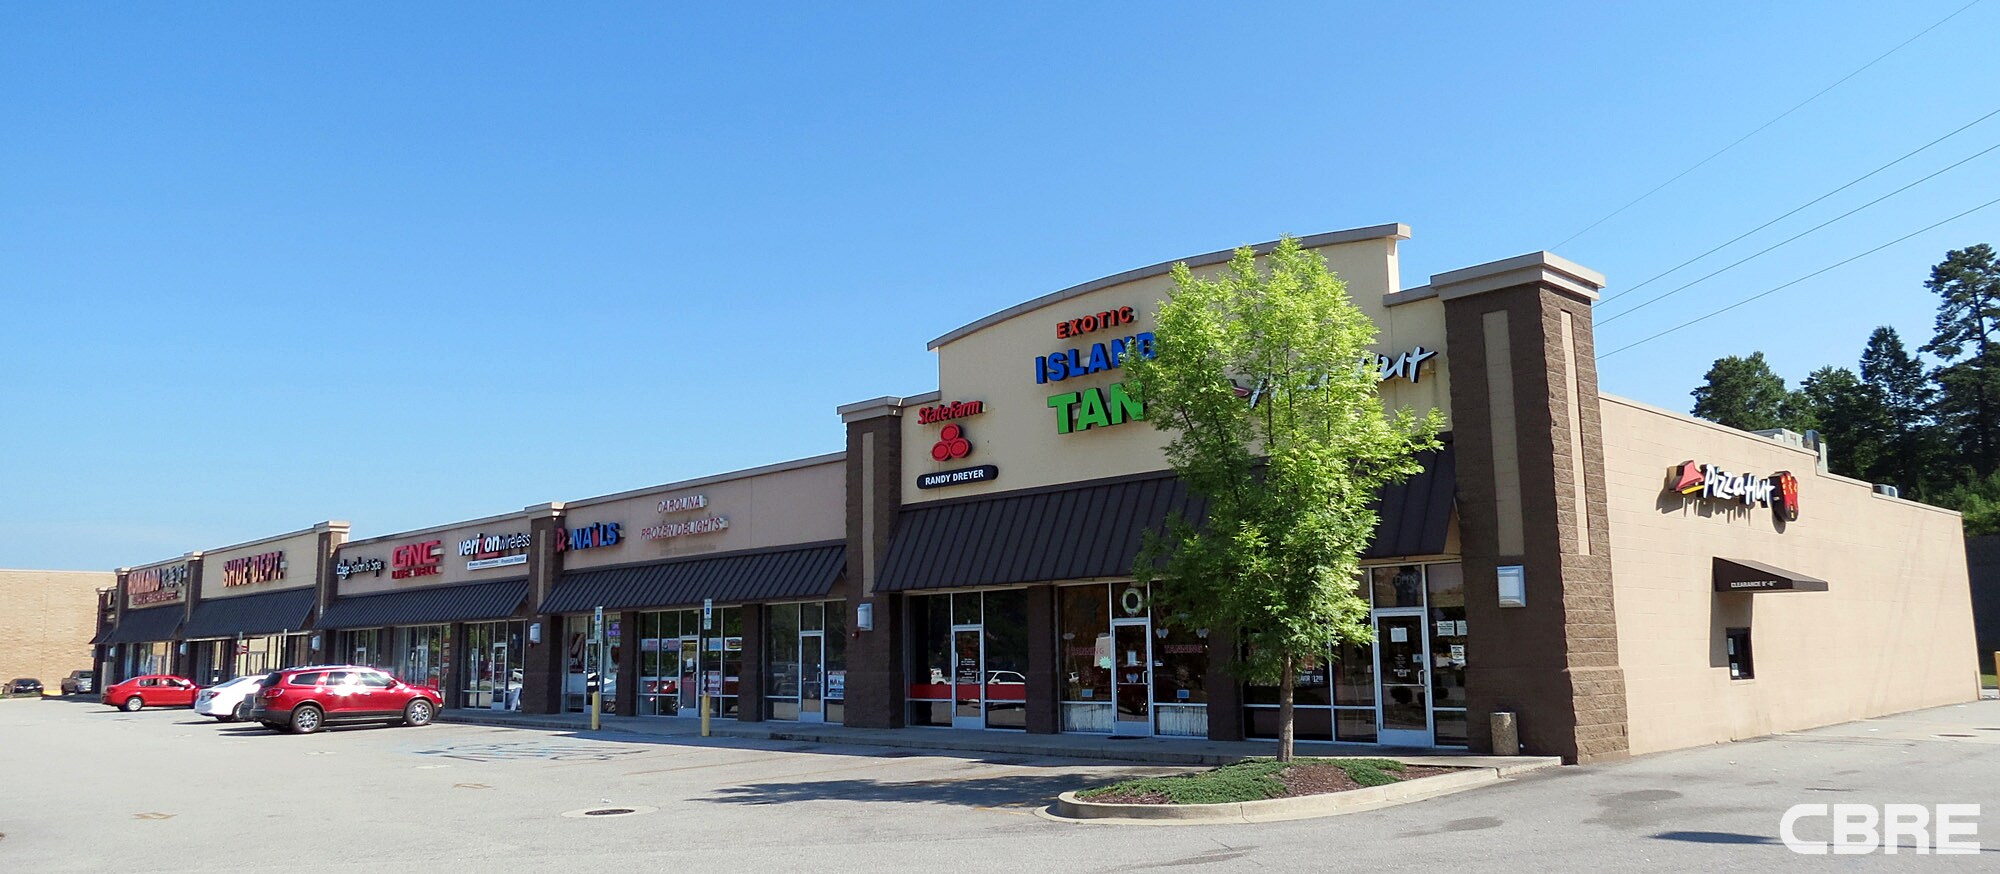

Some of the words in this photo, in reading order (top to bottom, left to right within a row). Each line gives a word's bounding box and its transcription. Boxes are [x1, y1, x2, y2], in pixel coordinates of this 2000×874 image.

[1056, 305, 1133, 339] EXOTIC
[1035, 332, 1157, 385] ISLAND
[1047, 382, 1144, 435] TAN
[925, 473, 952, 486] RANDY
[952, 469, 985, 482] DREYER
[1703, 464, 1744, 500] Pizza
[1744, 473, 1775, 507] Hut
[656, 495, 705, 514] CAROLINA
[640, 523, 675, 540] FROZEN
[675, 517, 722, 537] DELIGHTS
[392, 540, 441, 569] GNC
[223, 559, 249, 587] SHOE
